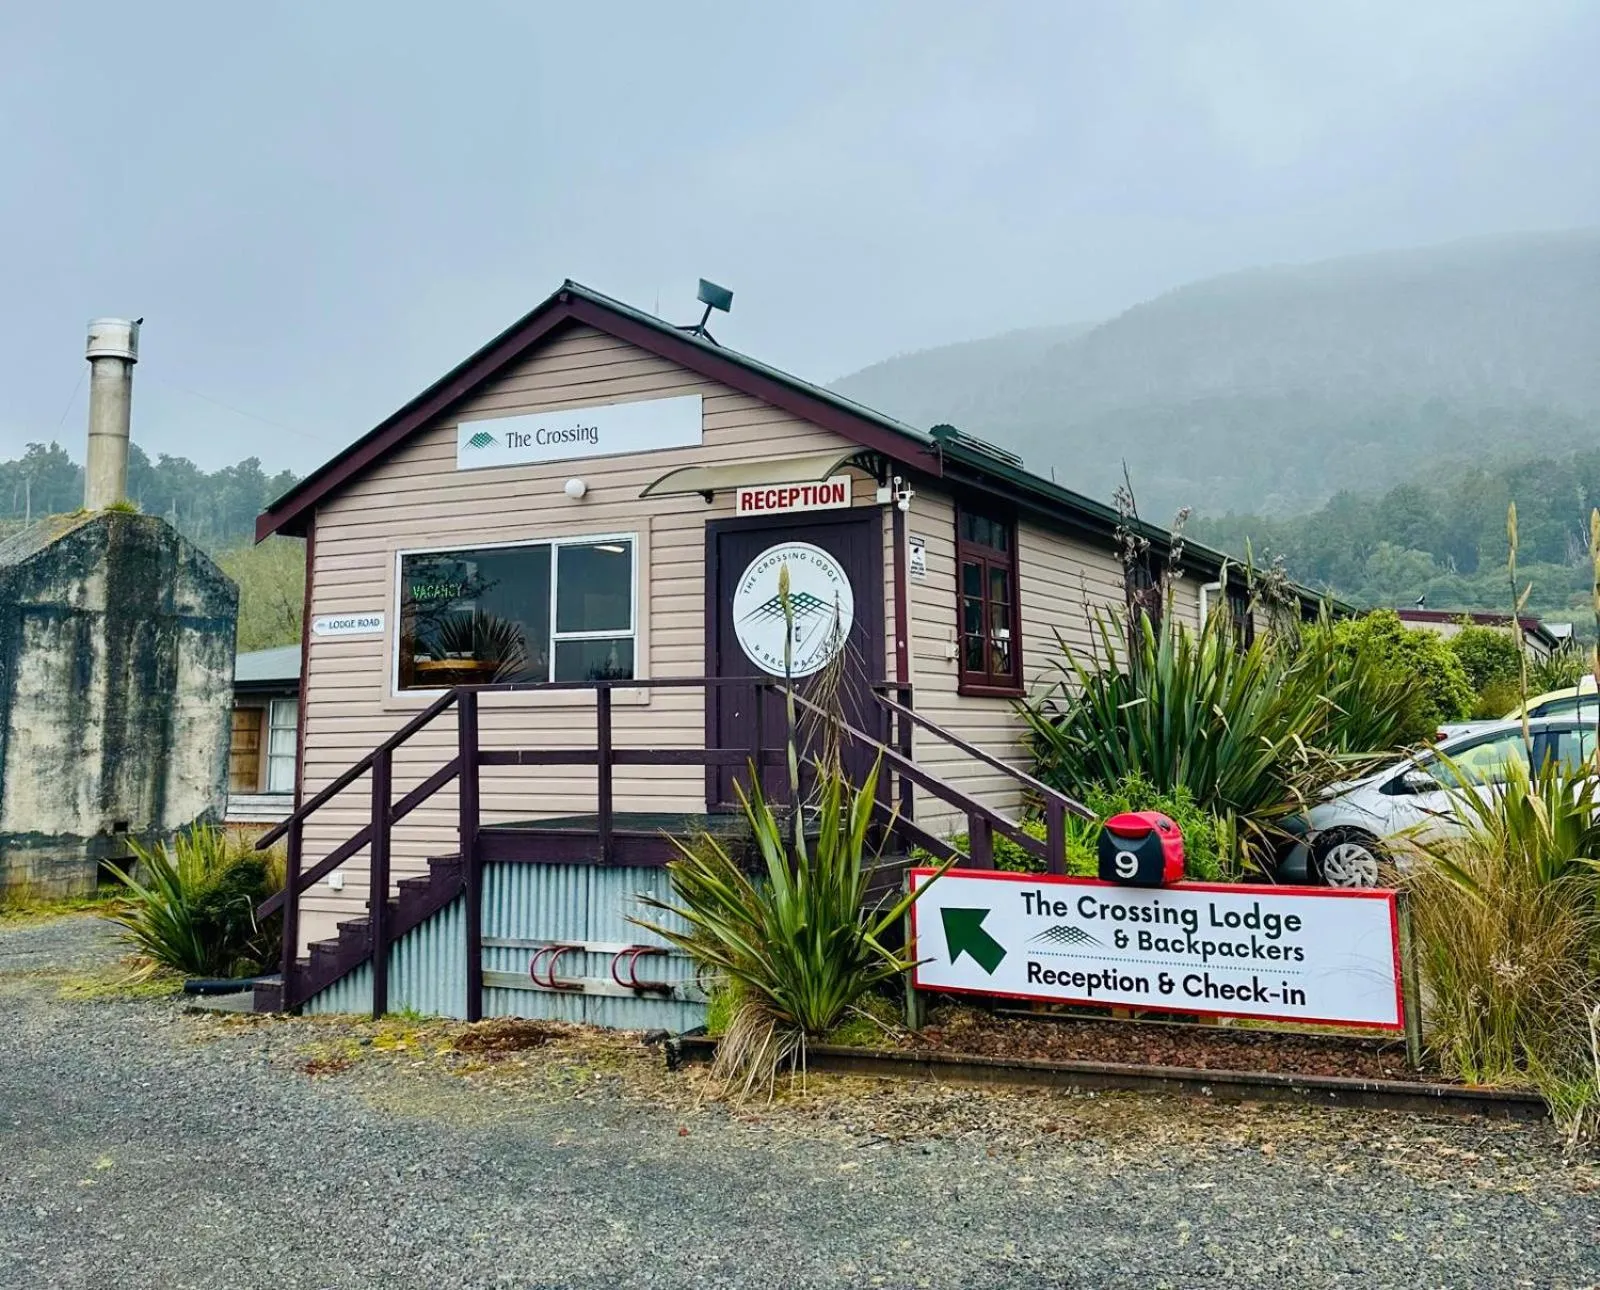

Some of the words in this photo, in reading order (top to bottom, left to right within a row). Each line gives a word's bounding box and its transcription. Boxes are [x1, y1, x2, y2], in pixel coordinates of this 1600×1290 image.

[505, 431, 532, 449] The
[536, 424, 599, 446] Crossing
[741, 483, 845, 511] RECEPTION
[743, 576, 756, 595] THE
[757, 552, 807, 574] CROSSING
[811, 556, 839, 582] LODGE
[412, 583, 462, 599] VACANCY
[328, 619, 355, 630] LODGE
[357, 618, 381, 628] ROAD
[1114, 851, 1139, 878] 9
[1020, 890, 1068, 917] The
[1077, 895, 1199, 935] Crossing
[1209, 902, 1302, 940] Lodge
[1114, 929, 1130, 949] &
[1138, 930, 1305, 963] Backpackers
[1027, 961, 1150, 997] Reception
[1158, 972, 1175, 995] &
[1182, 974, 1307, 1006] Check-in
